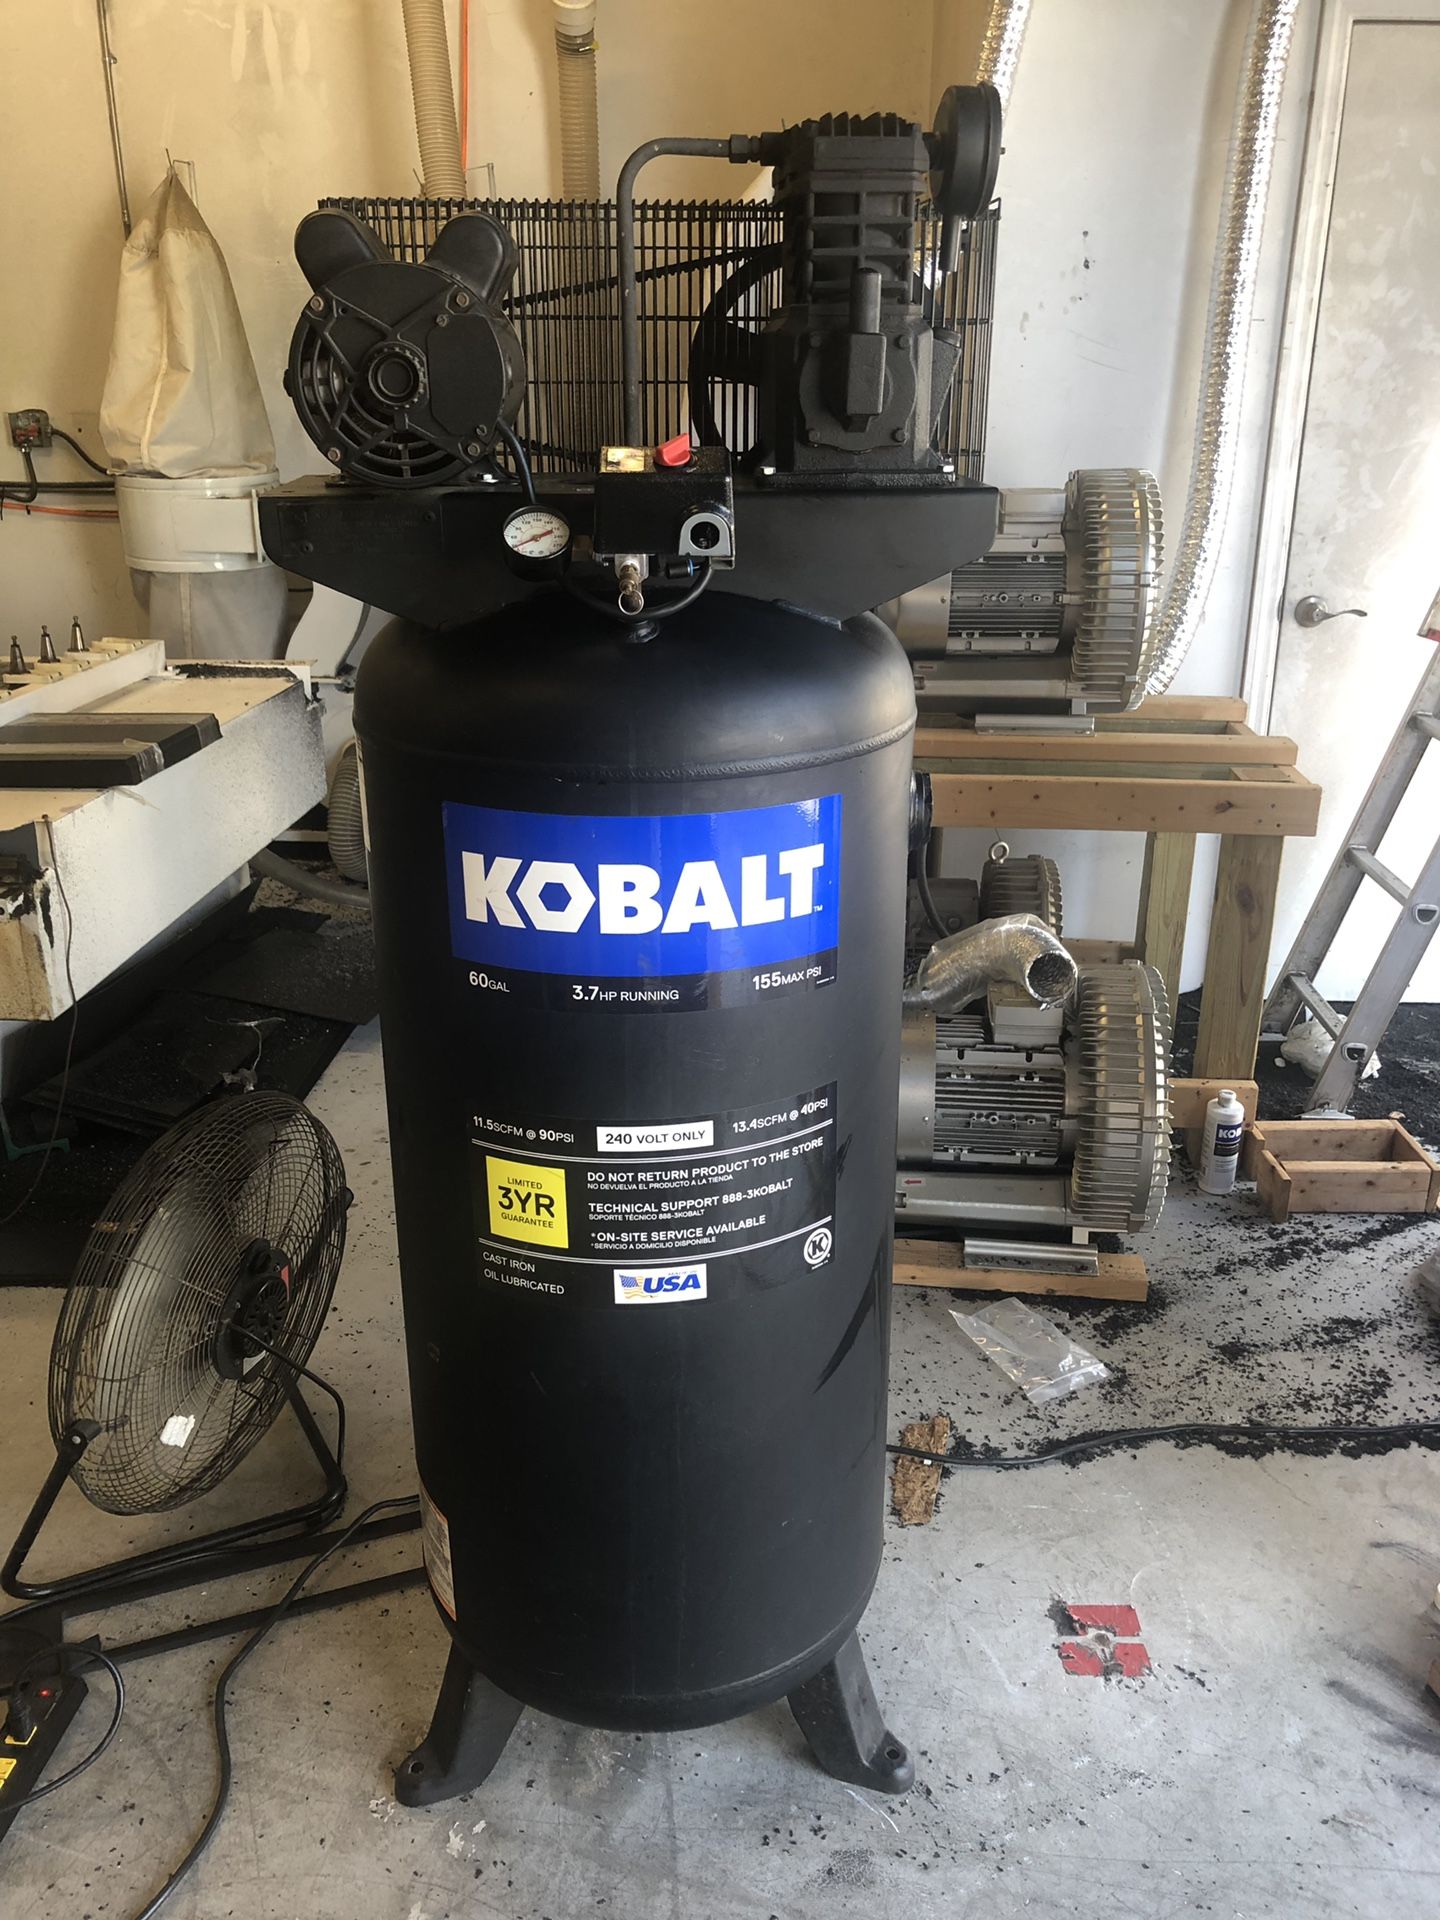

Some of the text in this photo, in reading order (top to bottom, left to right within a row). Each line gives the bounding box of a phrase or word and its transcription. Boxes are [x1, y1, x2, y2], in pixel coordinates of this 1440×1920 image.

[461, 843, 824, 934] KOBALT
[469, 970, 510, 993] 60GAL
[752, 971, 805, 991] 155MAX
[806, 965, 822, 979] PSI
[572, 984, 680, 1001] 3.7HP RUNNING
[732, 1097, 829, 1133] 13.4SCFM @ 40PSI
[473, 1115, 575, 1143] 11.5SCFM @ 90PSI
[605, 1130, 706, 1145] 240 VOLT ONLY
[587, 1136, 824, 1182] DO NOT RETURN PRODUCT TO THE STORE
[507, 1176, 543, 1190] LIMITED
[649, 1180, 690, 1189] PRODUCTO
[698, 1178, 707, 1186] LA
[708, 1173, 734, 1184] TIENDA
[498, 1185, 555, 1218] 3YR
[588, 1177, 794, 1213] TECHNICAL SUPPORT 888-3KOBALT
[501, 1212, 555, 1229] GUARANTEE
[654, 1227, 703, 1242] SERVICE
[706, 1214, 767, 1236] AVAILABLE
[636, 1241, 673, 1250] DOMICILIO
[674, 1235, 717, 1248] DISPONIBLE
[482, 1251, 536, 1273] CAST IRON
[483, 1268, 565, 1295] OIL LUBRICATED
[643, 1274, 701, 1294] USA
